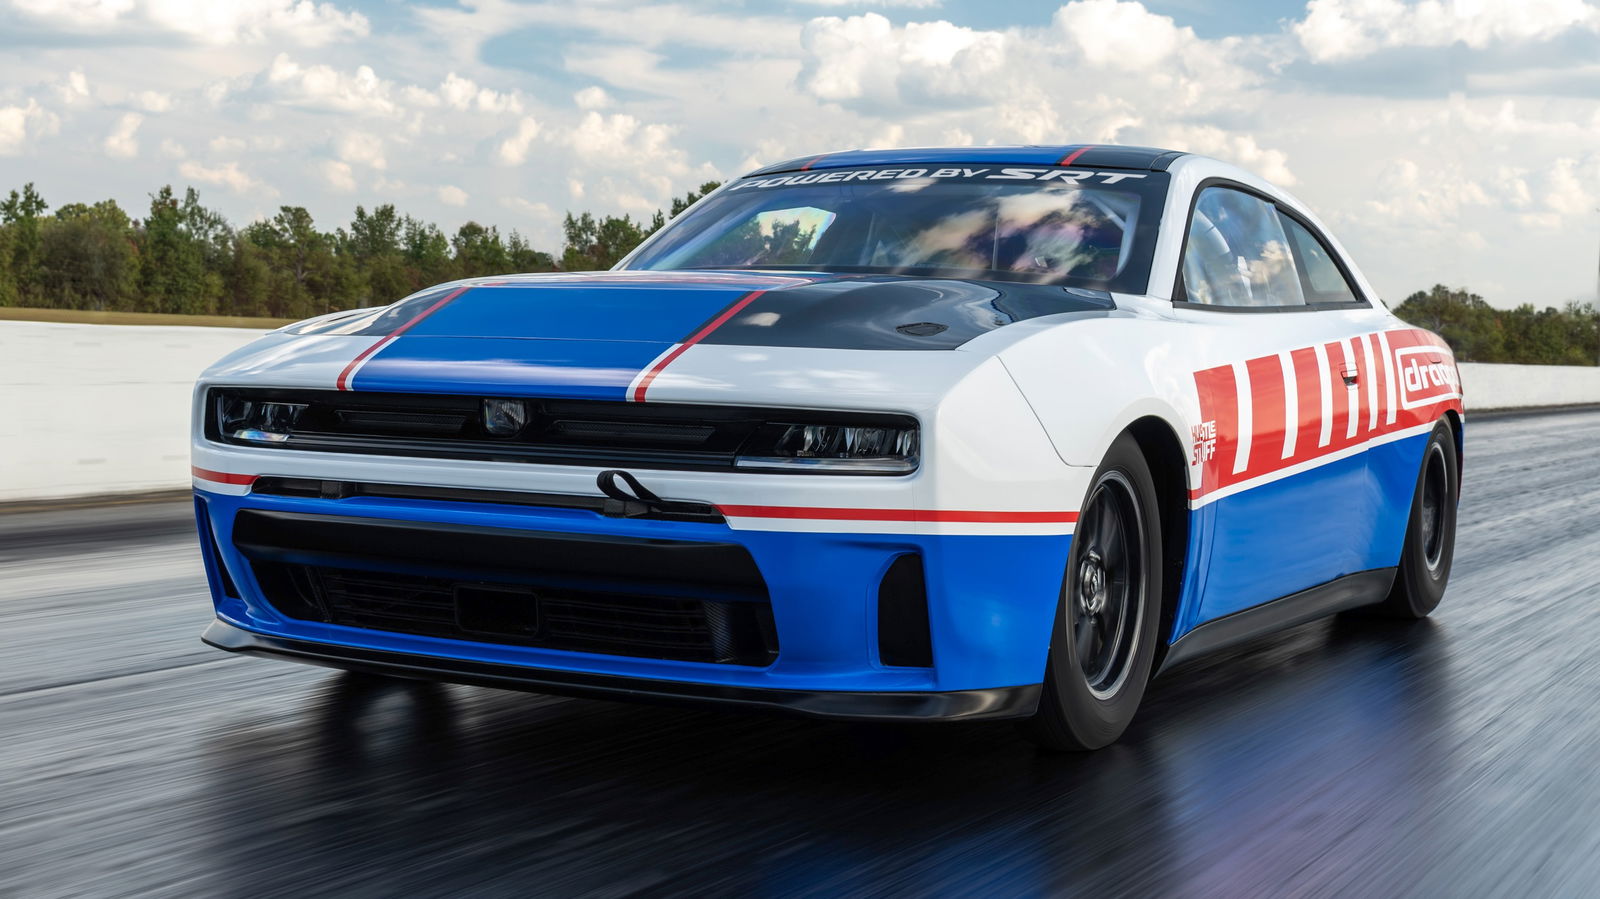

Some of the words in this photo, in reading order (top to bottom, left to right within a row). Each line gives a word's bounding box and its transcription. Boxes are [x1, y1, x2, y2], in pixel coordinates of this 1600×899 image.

[728, 168, 928, 192] POWERED
[929, 167, 990, 178] BY
[985, 168, 1148, 185] SRT
[1192, 439, 1217, 466] STUFF
